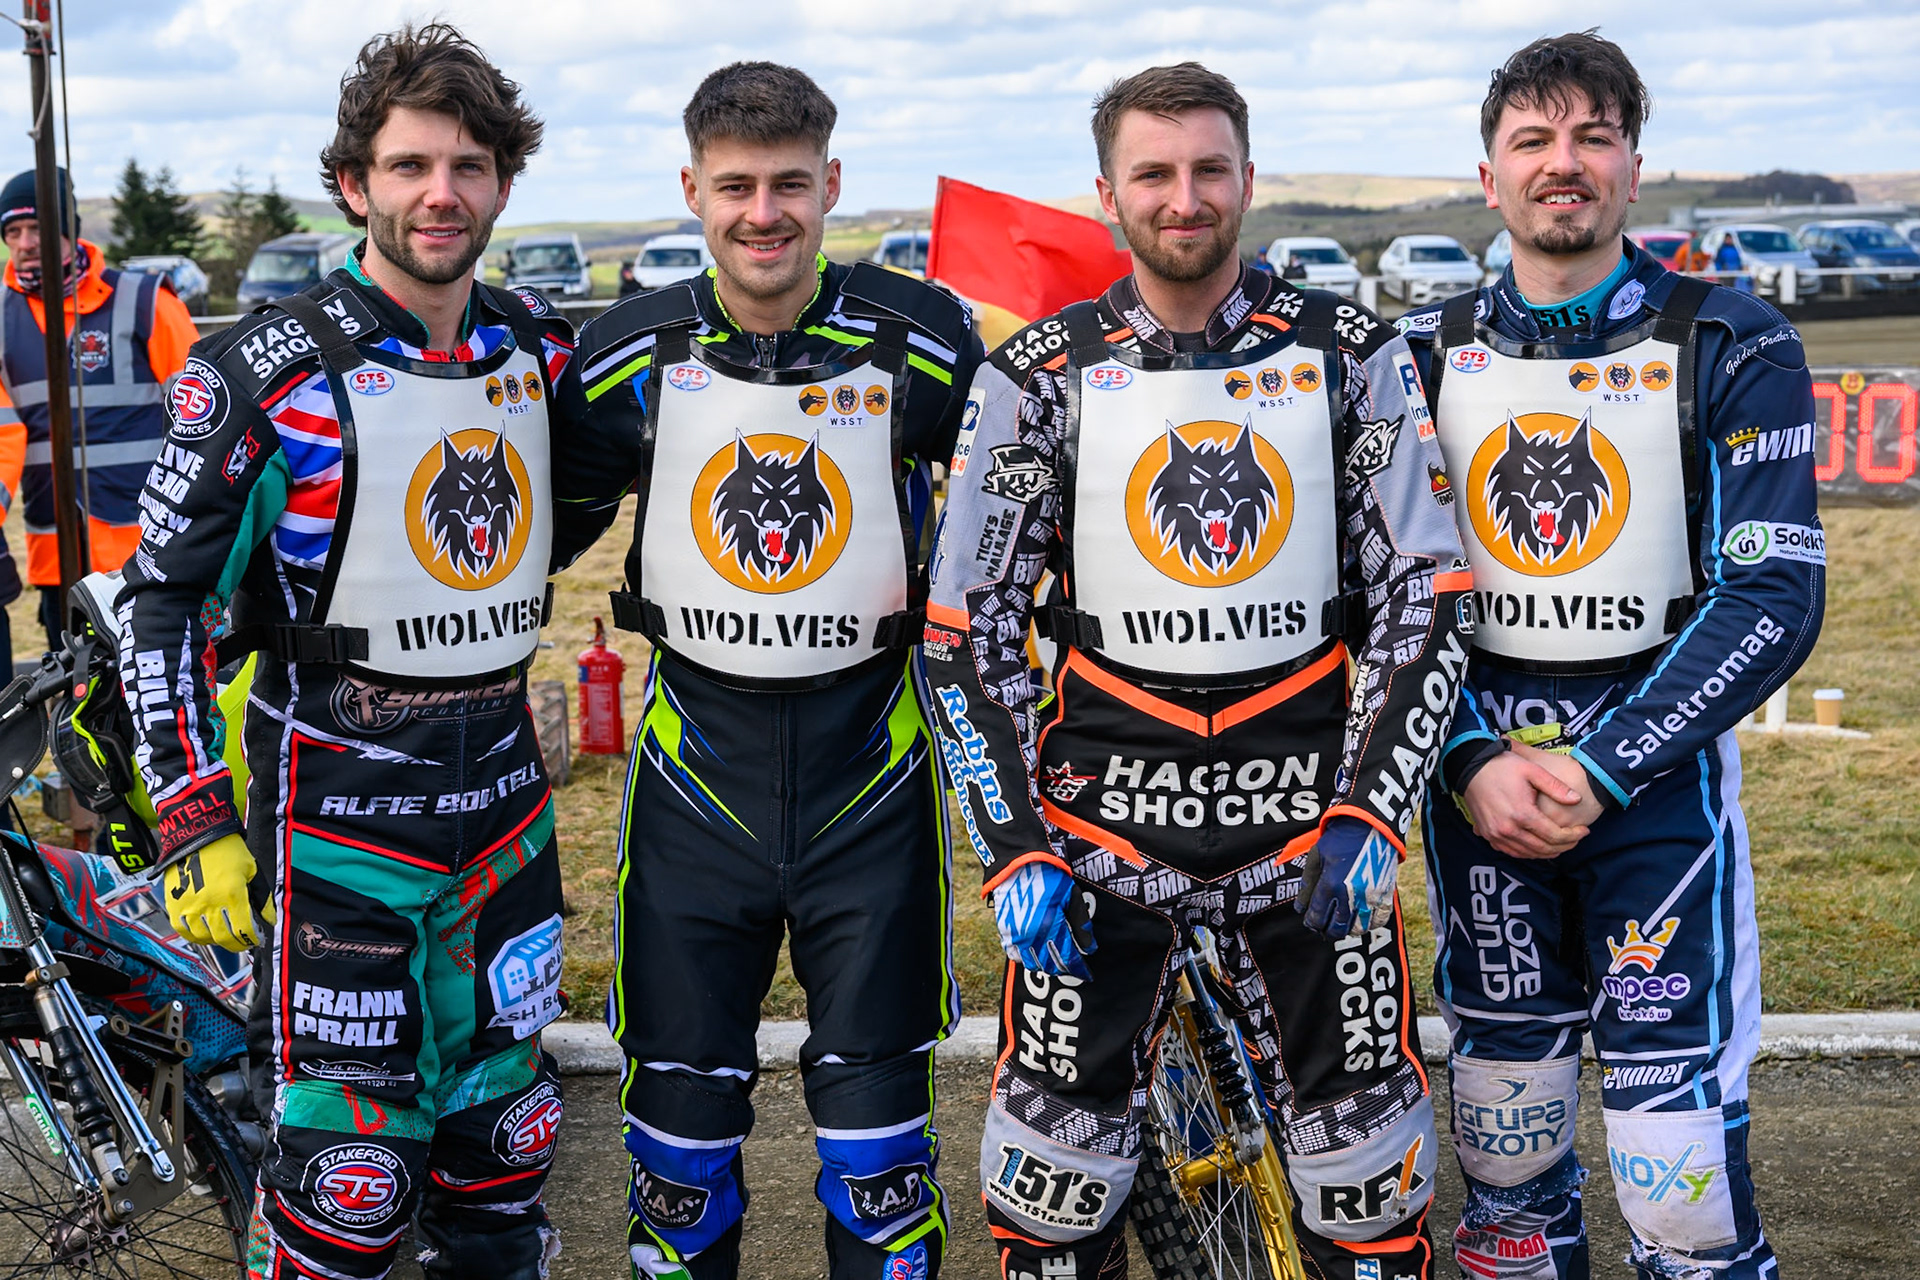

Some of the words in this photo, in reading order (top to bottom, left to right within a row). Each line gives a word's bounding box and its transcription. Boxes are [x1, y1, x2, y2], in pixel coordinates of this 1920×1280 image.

[240, 298, 347, 365] HAGN
[253, 317, 361, 379] SHOS
[676, 367, 704, 380] GTS
[1459, 350, 1486, 362] GTS
[1725, 345, 1757, 376] Golden
[1758, 331, 1791, 350] Panther
[356, 372, 385, 384] GTS
[1094, 370, 1124, 380] GTS
[507, 405, 529, 415] WSST
[1258, 397, 1295, 409] WSST
[1603, 393, 1641, 402] WSST
[829, 417, 864, 426] WSST
[976, 514, 999, 562] TICK'S
[985, 508, 1016, 580] HAULAGE
[1774, 526, 1825, 553] Solekt
[396, 596, 540, 651] WOLVES
[681, 606, 860, 646] WOLVES
[1122, 600, 1306, 644] WOLVES
[1393, 639, 1407, 649] TEAM
[135, 650, 175, 731] BILL
[1615, 614, 1786, 770] Saletromag
[1368, 631, 1466, 822] HAGON
[935, 683, 1014, 825] Robins
[948, 739, 979, 785] of
[1103, 752, 1319, 795] HAGON
[320, 796, 426, 816] ALFIE
[1099, 791, 1321, 828] SHOCKS
[1144, 872, 1192, 906] BMR
[1236, 898, 1271, 915] BMR
[293, 981, 407, 1018] FRANK
[1334, 934, 1376, 1072] HOCKS
[1367, 926, 1400, 1068] AGON
[1604, 975, 1688, 1005] mpec
[294, 1012, 400, 1048] PRALL
[1018, 968, 1050, 1072] HAG
[502, 1085, 555, 1133] STAKEFORD
[513, 1101, 562, 1152] STS
[318, 1148, 398, 1171] STAKEFORD
[999, 1148, 1024, 1189] CAMERON
[1319, 1137, 1425, 1222] RFX
[320, 1173, 393, 1202] STS
[989, 1180, 1096, 1228] www.151s.co.uk
[317, 1194, 336, 1213] YRE
[337, 1203, 395, 1223] SERVICES
